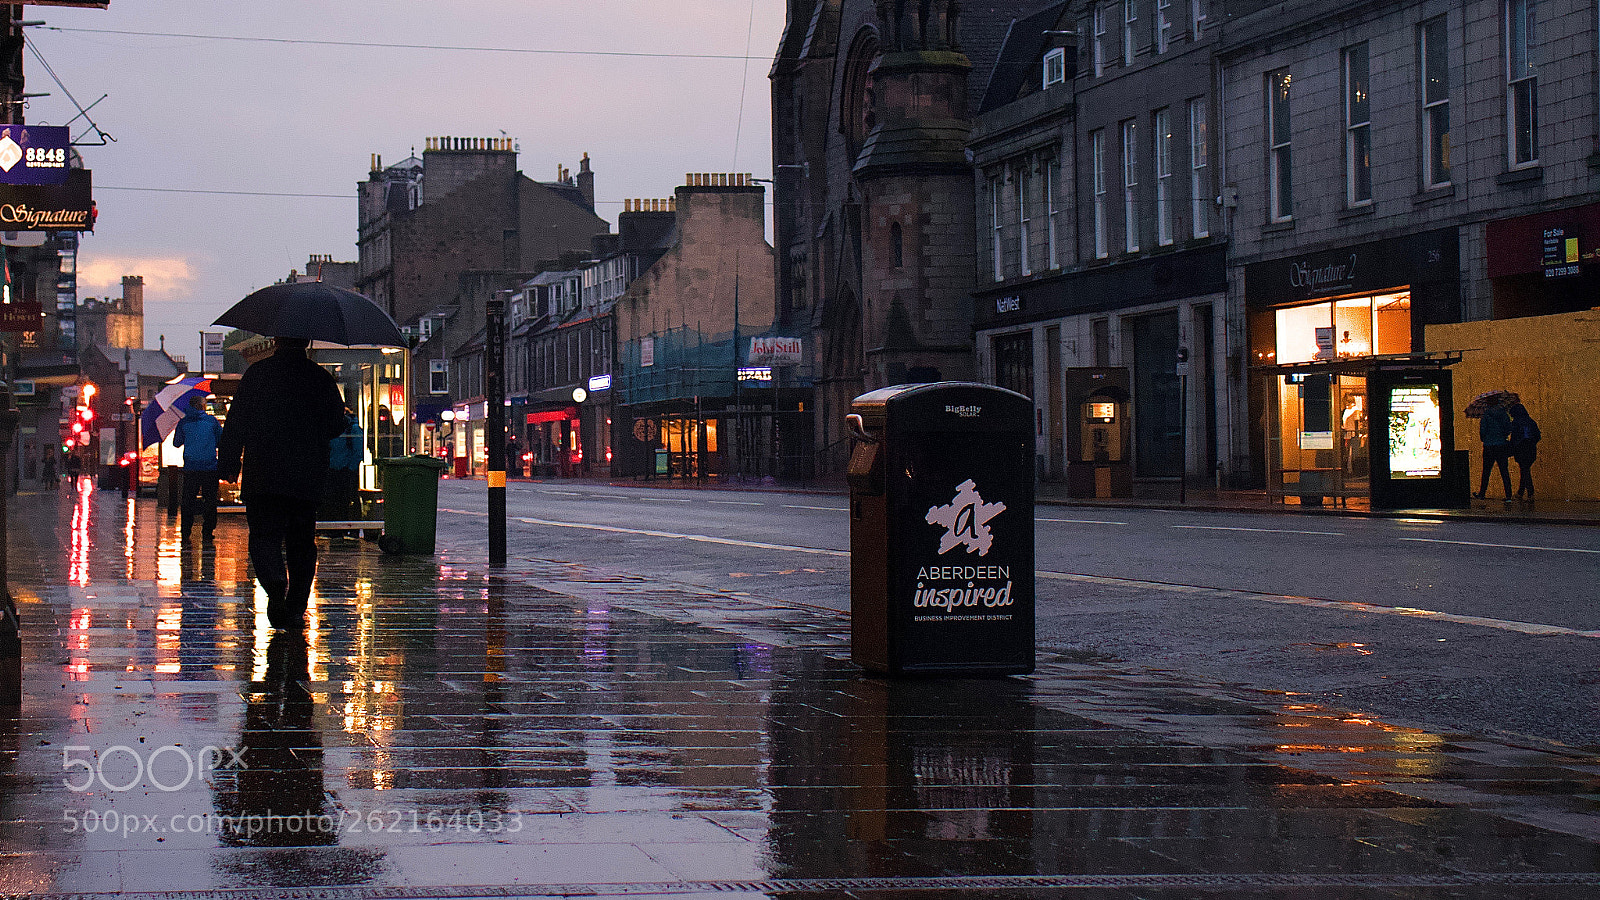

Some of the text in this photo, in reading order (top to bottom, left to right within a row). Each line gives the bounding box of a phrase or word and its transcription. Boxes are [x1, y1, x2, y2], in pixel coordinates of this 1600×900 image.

[25, 147, 65, 162] 8848
[0, 203, 88, 229] Signature
[1552, 227, 1565, 237] Sale
[1290, 253, 1357, 295] Signature 2
[996, 295, 1020, 314] NatWest
[775, 341, 800, 354] Still
[945, 405, 982, 413] BigBelly
[916, 565, 1010, 580] ABERDEEN
[913, 580, 1014, 613] inspired
